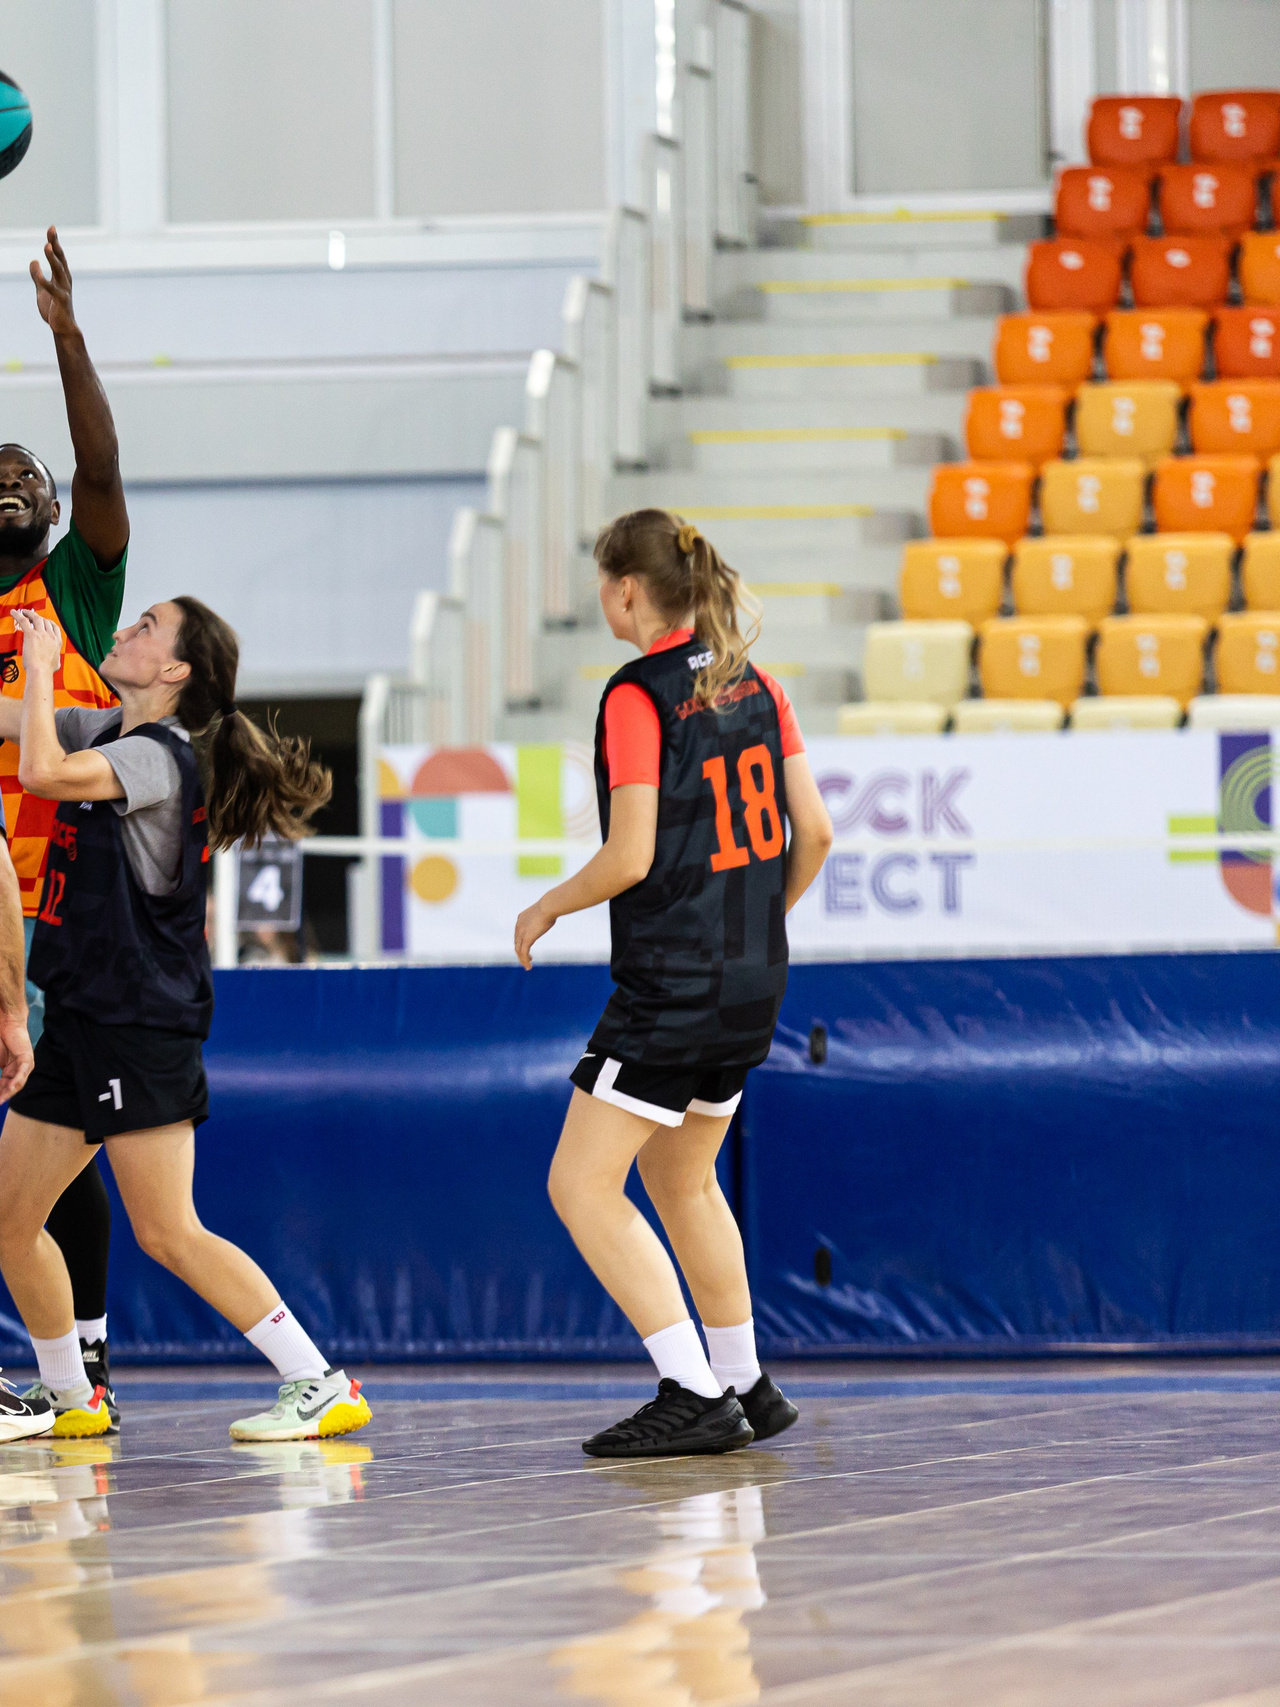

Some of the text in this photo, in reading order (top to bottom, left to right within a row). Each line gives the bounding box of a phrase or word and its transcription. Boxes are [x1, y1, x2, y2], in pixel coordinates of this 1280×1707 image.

[702, 743, 784, 873] 18
[818, 767, 974, 835] ССК
[247, 864, 285, 913] 4
[824, 850, 976, 918] ЕСТ
